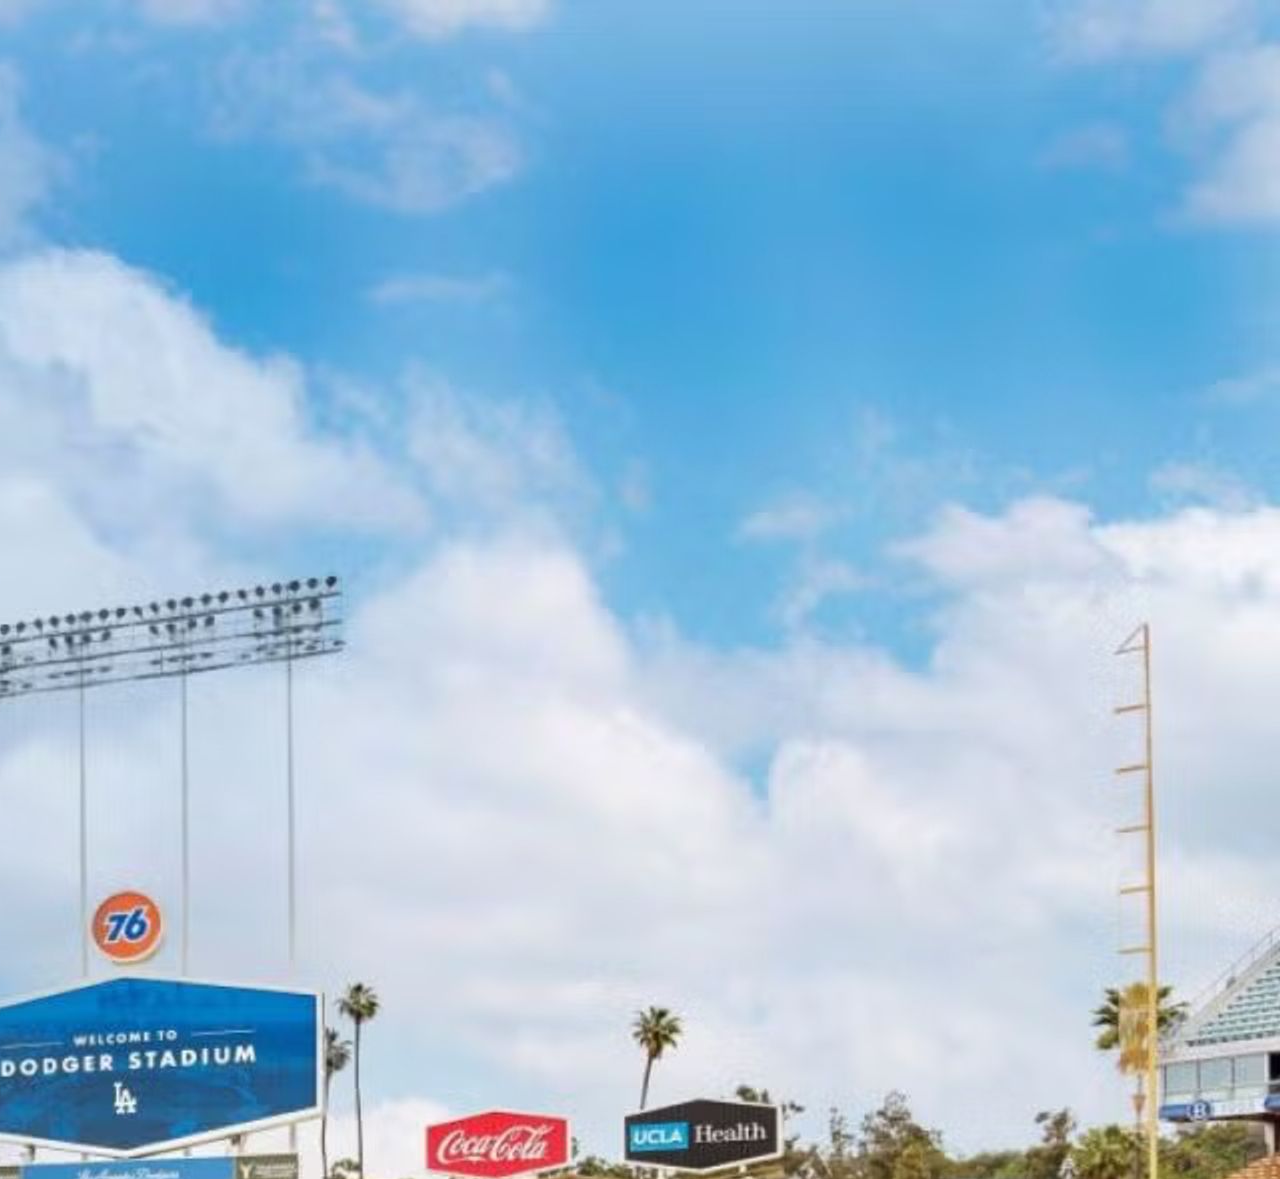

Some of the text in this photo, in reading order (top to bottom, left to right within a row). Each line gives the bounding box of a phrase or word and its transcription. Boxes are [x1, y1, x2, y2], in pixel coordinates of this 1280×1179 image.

[106, 908, 148, 942] 76
[73, 1030, 178, 1047] WELCOME TO
[0, 1045, 257, 1078] DODGER STADIUM
[113, 1081, 138, 1115] LA
[633, 1122, 768, 1146] UCLA Health
